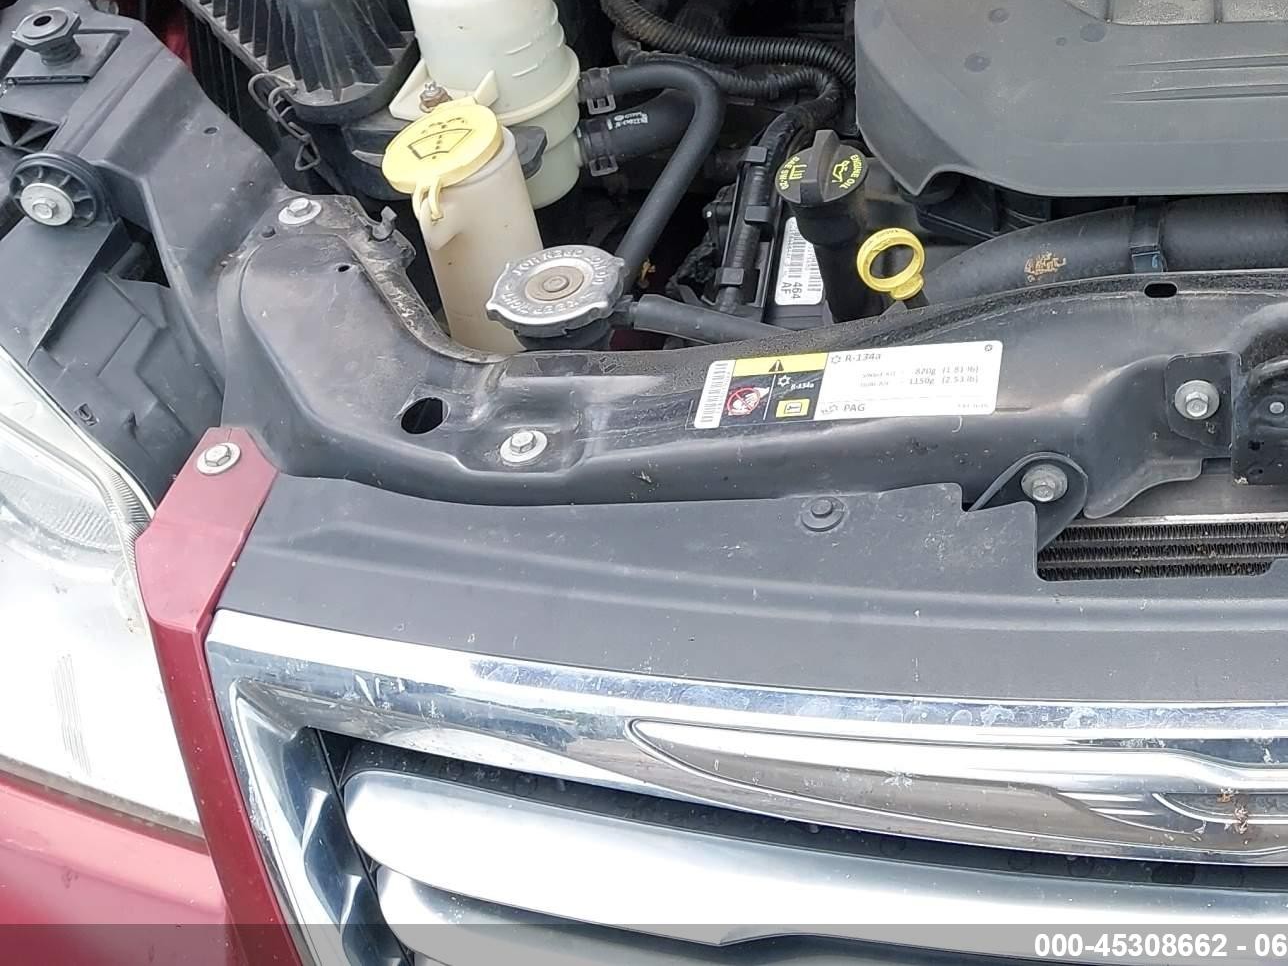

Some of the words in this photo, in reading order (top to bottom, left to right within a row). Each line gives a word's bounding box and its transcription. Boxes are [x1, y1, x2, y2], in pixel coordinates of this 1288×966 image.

[784, 156, 800, 169] SAE
[850, 154, 862, 178] ENGINE
[779, 170, 789, 190] 5W-20
[839, 178, 855, 189] OIL
[781, 282, 792, 294] AF
[791, 282, 803, 299] 464
[844, 353, 881, 363] R-134a
[843, 403, 866, 413] PAG
